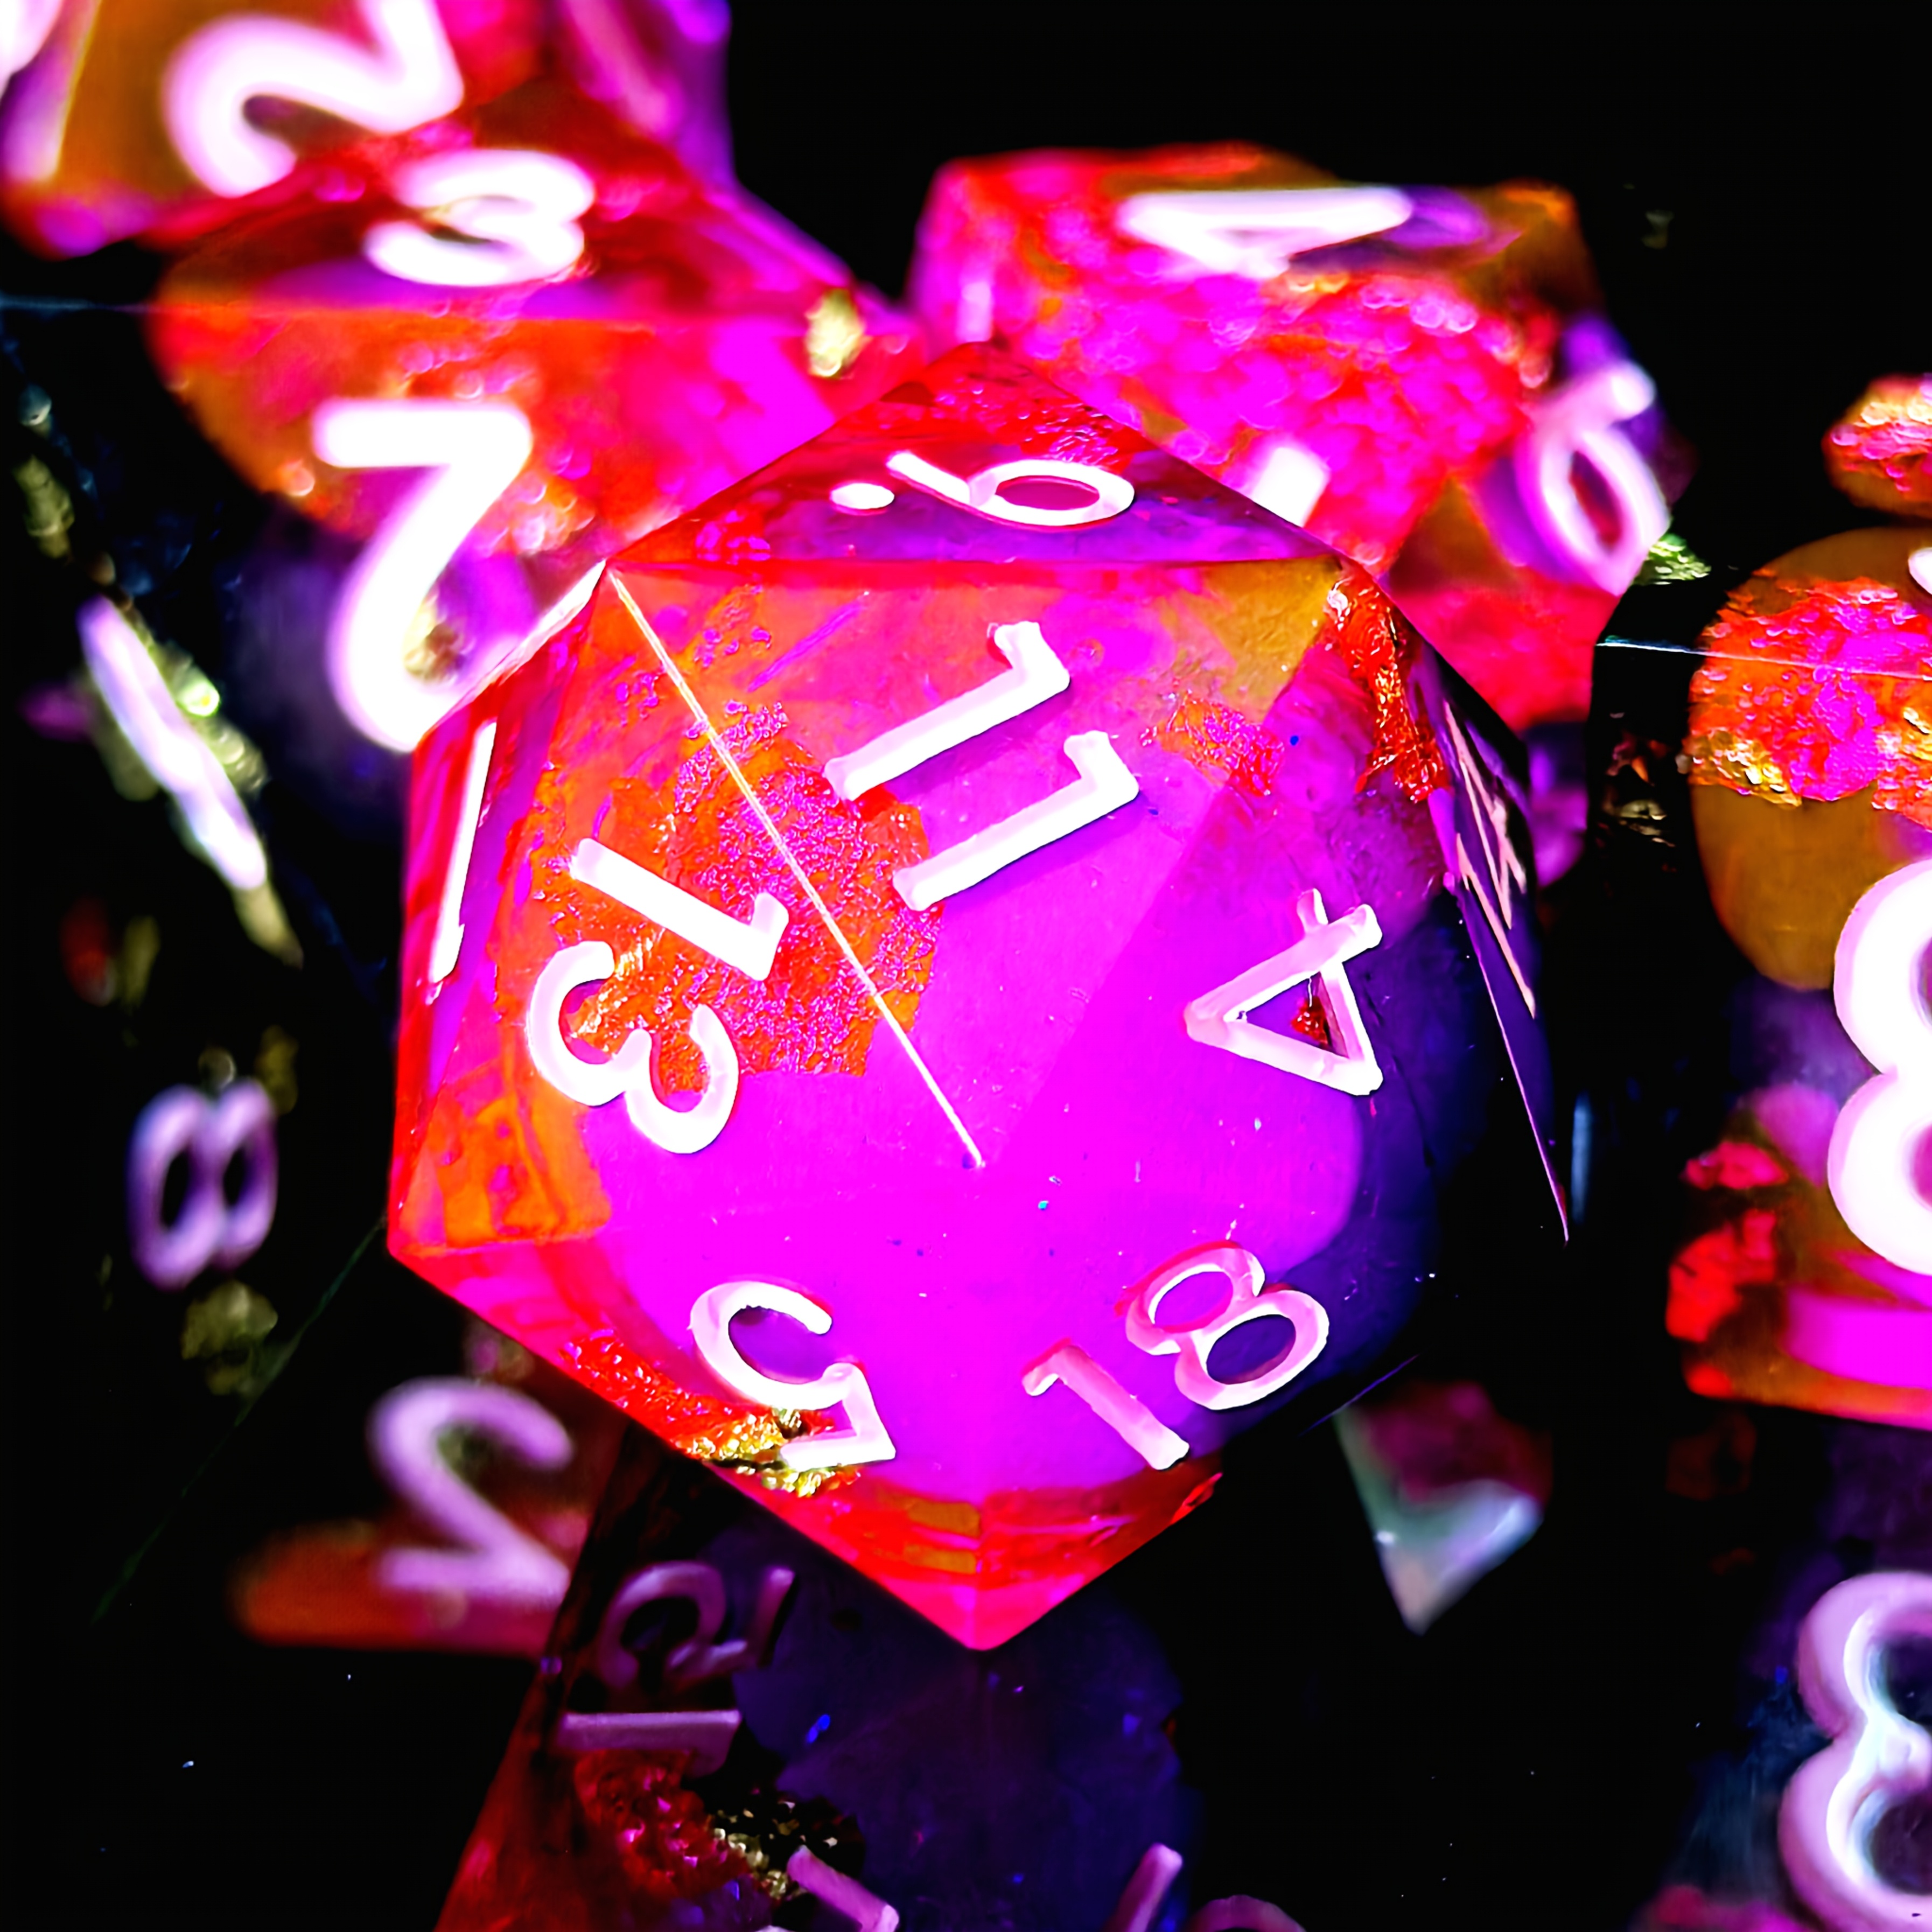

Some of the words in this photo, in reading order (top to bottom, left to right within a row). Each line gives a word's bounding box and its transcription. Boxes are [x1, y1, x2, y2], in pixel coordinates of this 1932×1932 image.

[360, 148, 597, 286] 3
[824, 620, 1139, 912] 11
[528, 837, 790, 1154] 13
[1184, 887, 1384, 1096] 4
[689, 1279, 897, 1473] 5
[1021, 1240, 1330, 1471] 18
